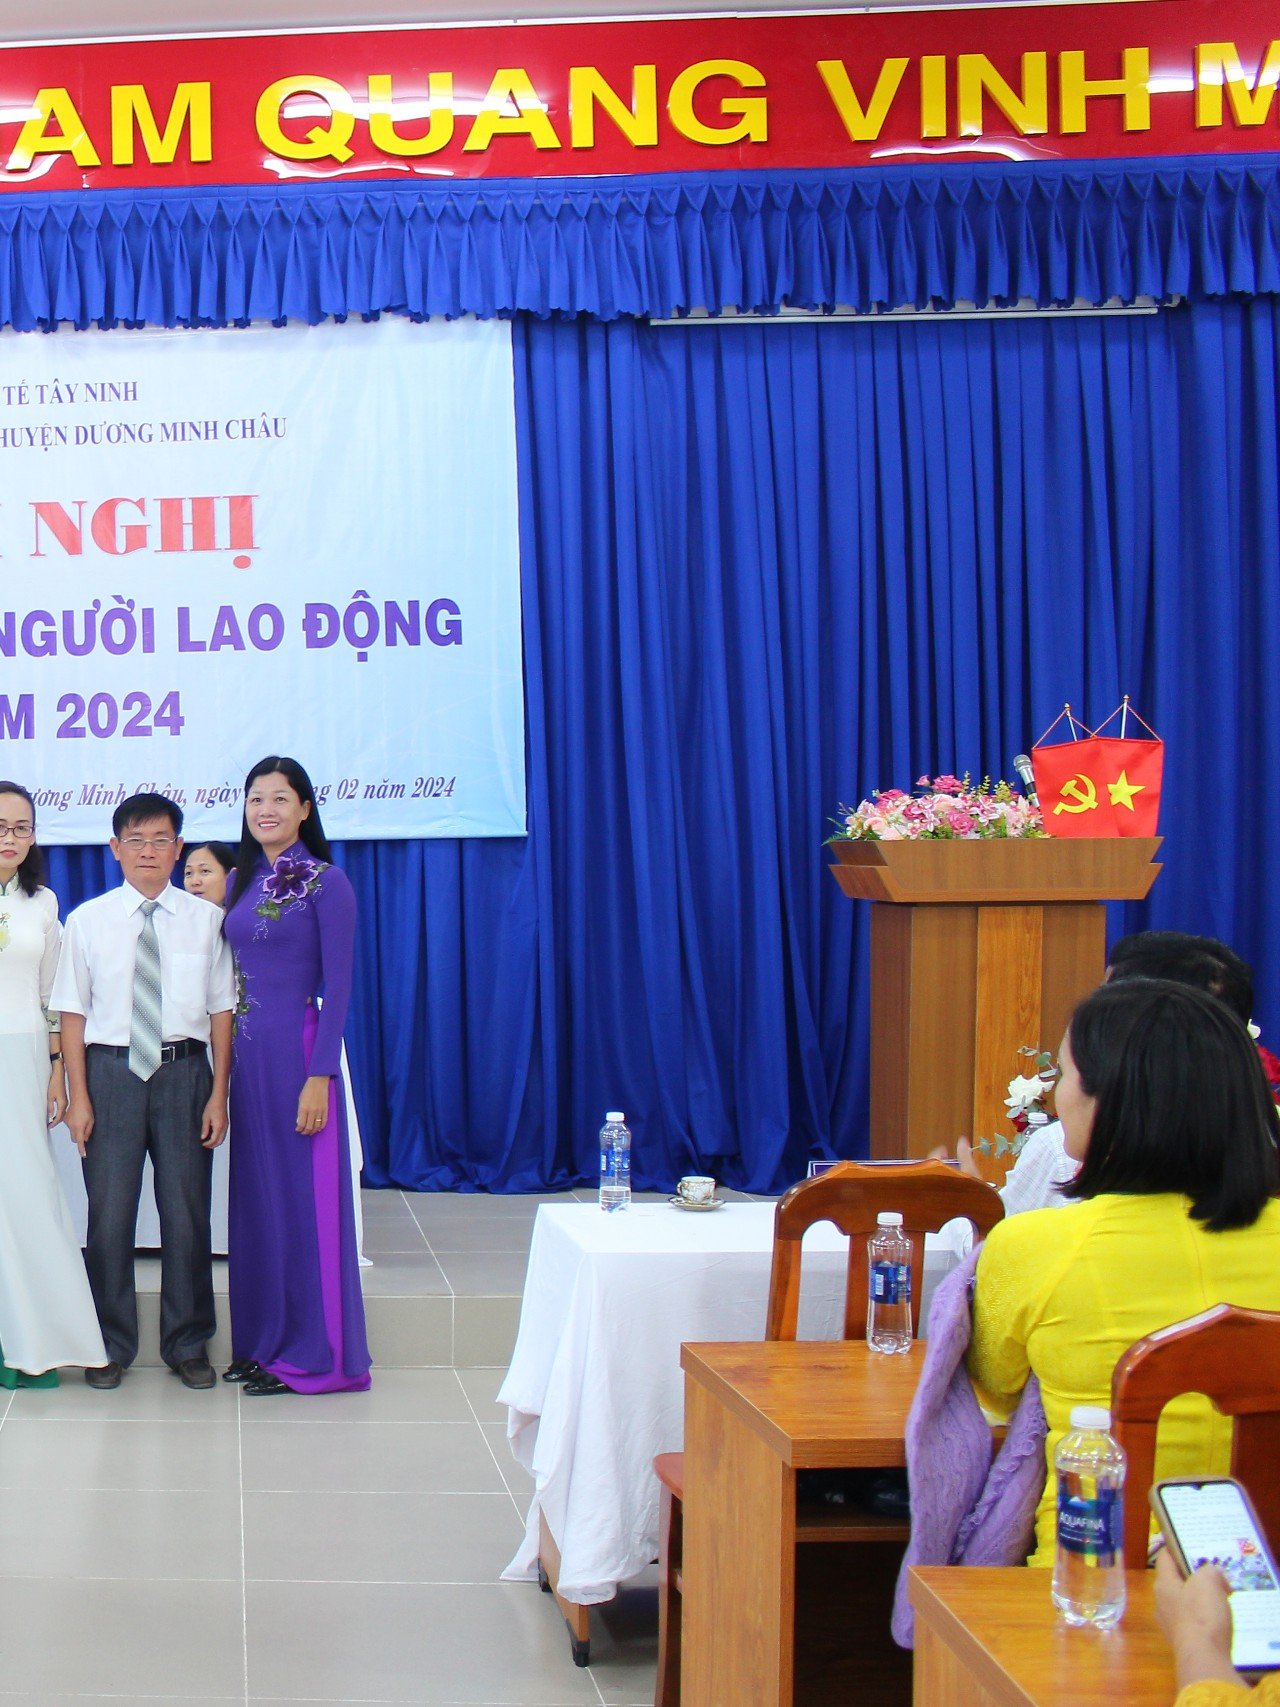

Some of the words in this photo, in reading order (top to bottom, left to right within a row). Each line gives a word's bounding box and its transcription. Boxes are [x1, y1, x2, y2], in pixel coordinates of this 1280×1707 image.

[255, 59, 769, 163] QUANG
[816, 47, 1152, 141] VINH
[1194, 40, 1280, 127] M
[3, 378, 30, 405] TẾ
[35, 378, 79, 405] TÂY
[84, 381, 138, 403] NINH
[74, 420, 154, 446] DƯƠNG
[159, 420, 219, 443] MINH
[224, 412, 287, 440] CHÂU
[28, 494, 261, 569] NGHỊ
[177, 603, 284, 653] LAO
[302, 590, 462, 663] ĐỘNG
[56, 691, 185, 739] 2024
[19, 786, 74, 811] ương
[77, 783, 126, 806] Minh
[195, 782, 242, 808] ngày
[337, 778, 360, 800] 02
[363, 777, 406, 799] năm
[410, 776, 457, 799] 2024
